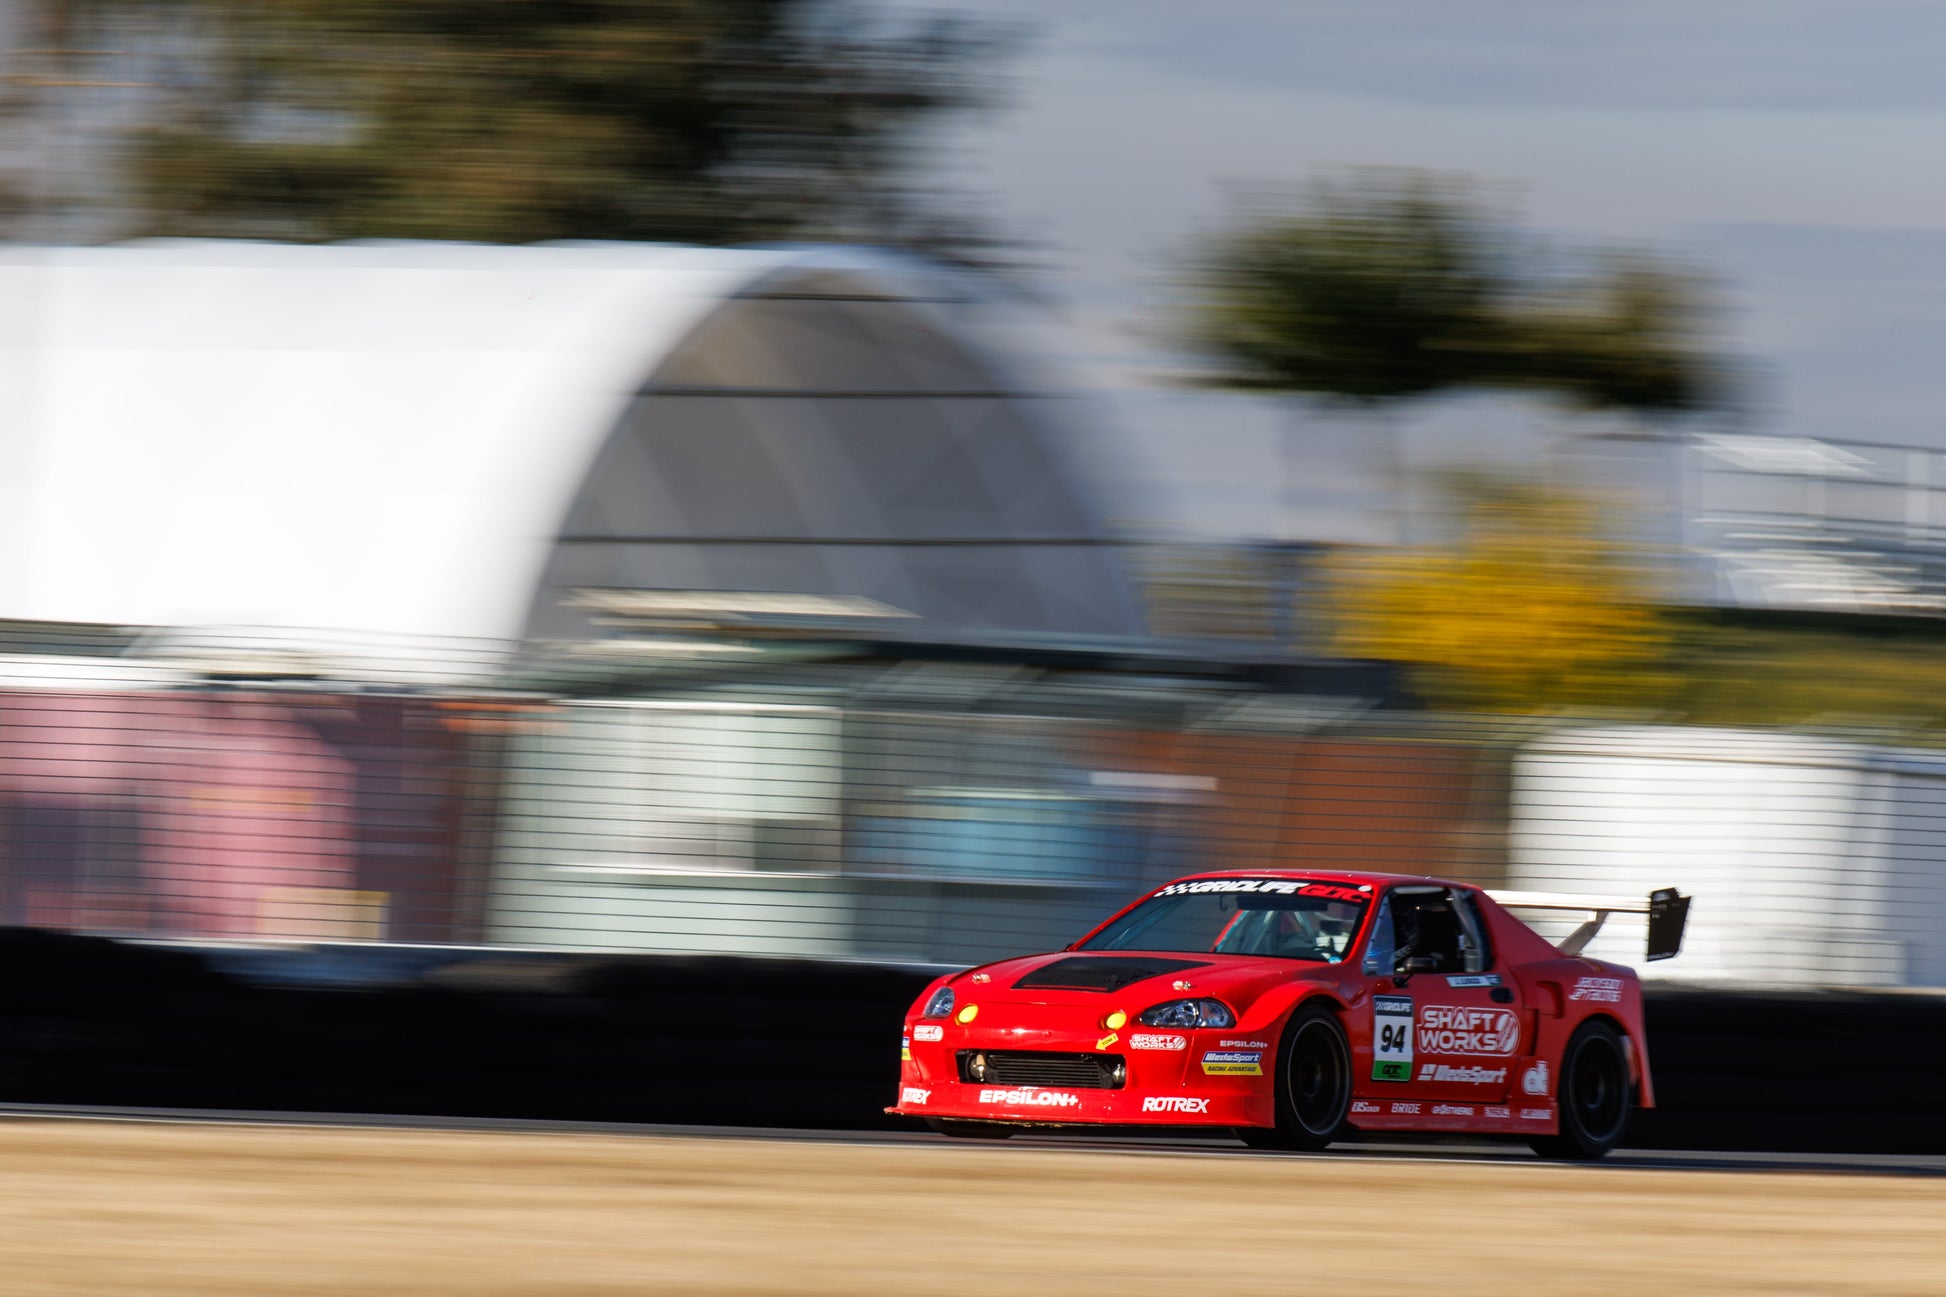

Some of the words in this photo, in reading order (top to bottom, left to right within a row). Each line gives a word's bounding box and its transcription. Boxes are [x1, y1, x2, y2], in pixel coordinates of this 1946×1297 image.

[1188, 880, 1309, 895] GRIDLIFE
[1423, 1010, 1495, 1031] SHAFT
[1130, 1041, 1174, 1049] WORKS
[1219, 1040, 1268, 1048] EPSILON+
[1380, 1024, 1407, 1053] 94
[1420, 1030, 1498, 1051] WORKS
[1204, 1052, 1260, 1063] WedsSport
[1227, 1065, 1257, 1073] ADVANTAGE
[979, 1089, 1078, 1106] EPSILON+
[1142, 1097, 1210, 1113] ROTREX
[1391, 1103, 1422, 1114] BRIDE
